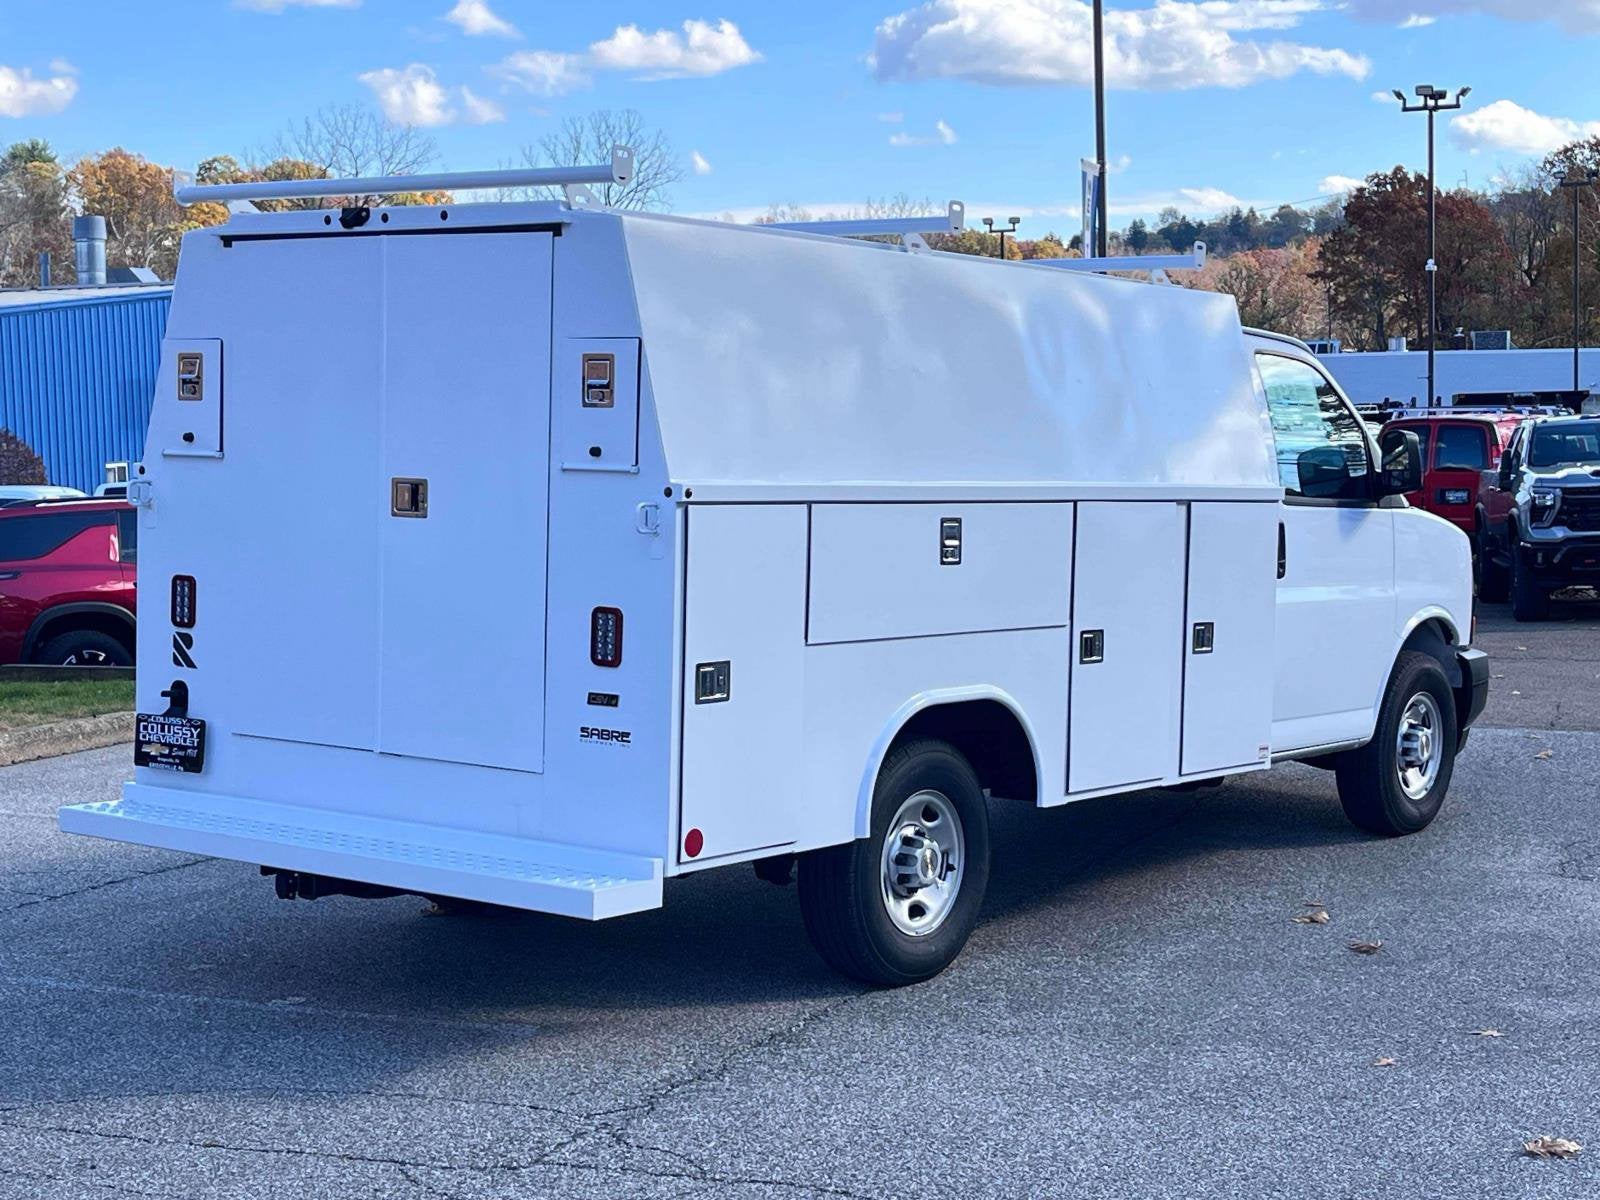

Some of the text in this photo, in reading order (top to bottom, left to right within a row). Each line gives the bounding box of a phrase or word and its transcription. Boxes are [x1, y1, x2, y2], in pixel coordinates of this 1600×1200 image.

[151, 715, 188, 726] COLUSSY
[140, 722, 201, 739] COLUSSY
[579, 726, 632, 744] SABRE
[139, 732, 200, 747] CHEVROLET
